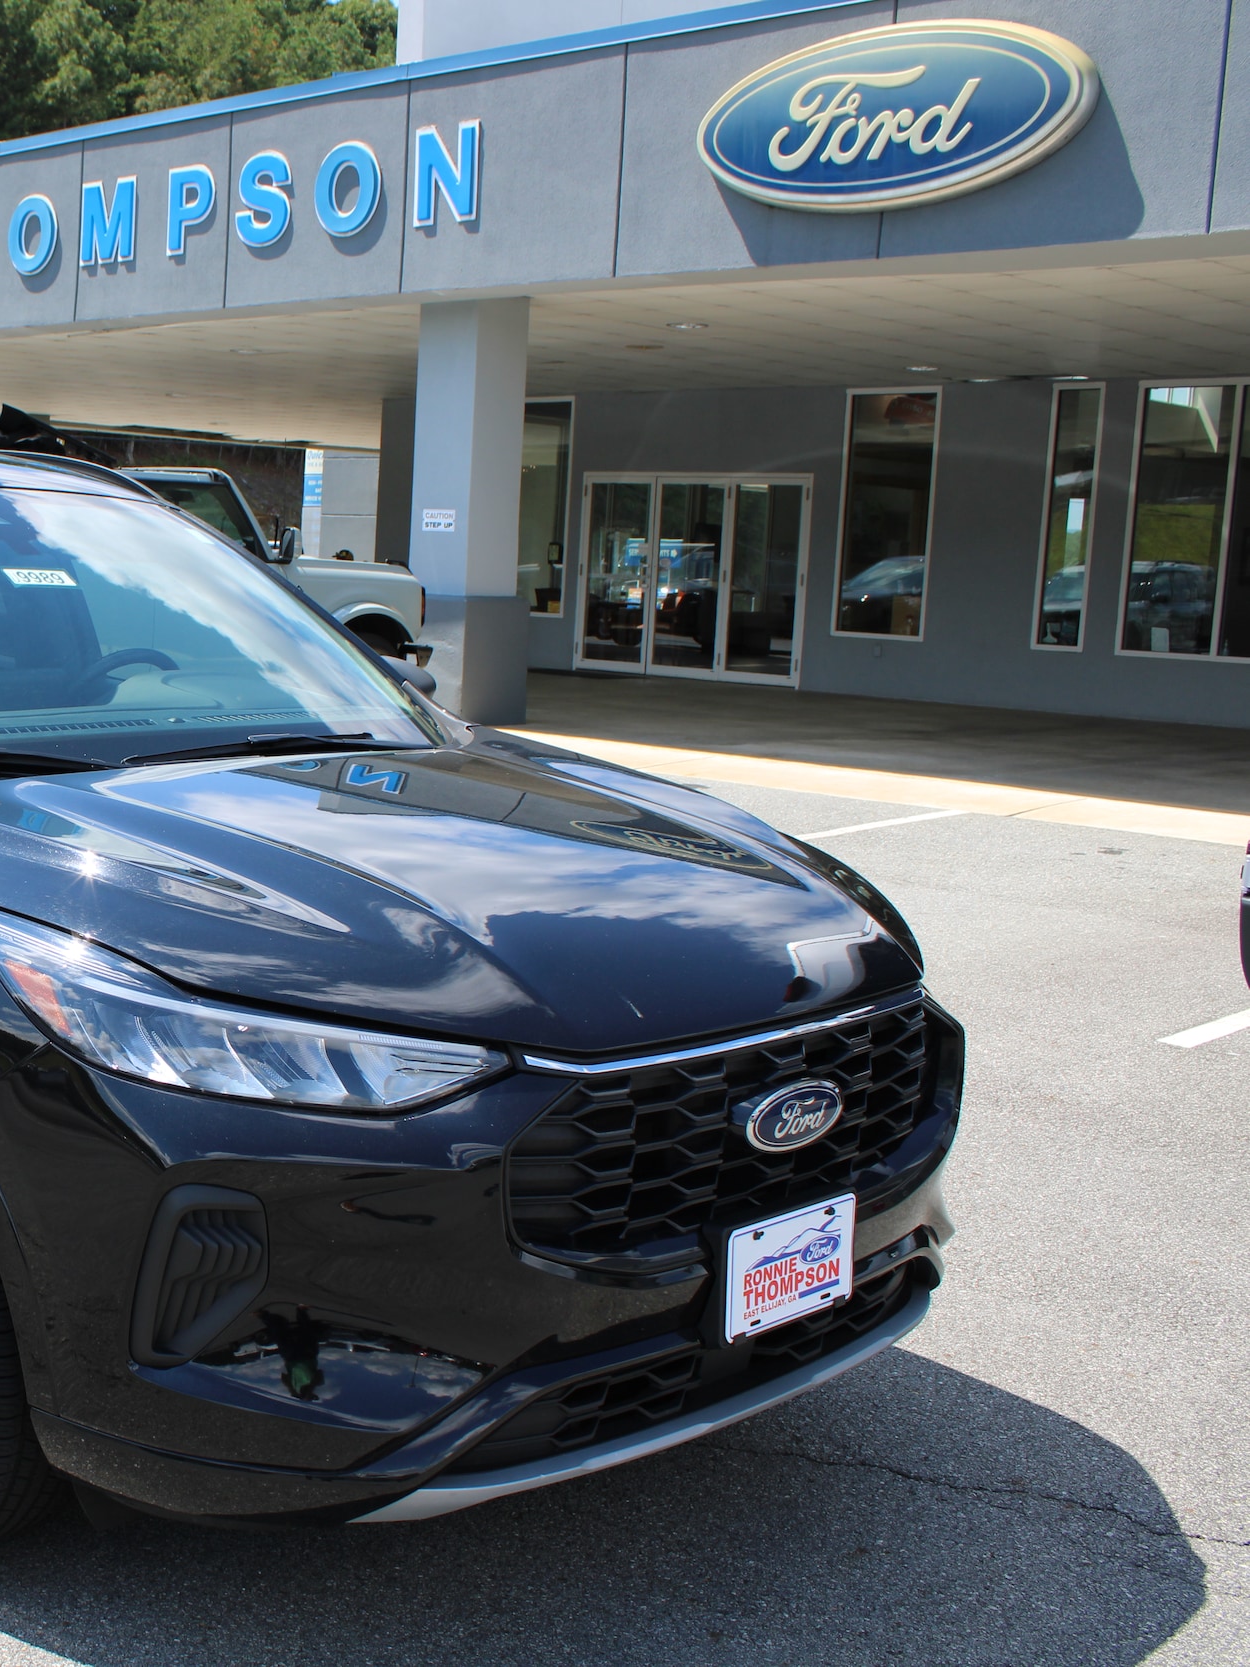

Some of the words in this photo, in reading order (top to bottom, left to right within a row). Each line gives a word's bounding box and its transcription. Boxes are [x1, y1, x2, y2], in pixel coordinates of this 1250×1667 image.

[768, 65, 982, 172] Ford
[424, 521, 442, 529] STEP
[425, 512, 454, 520] CAUTION
[16, 571, 65, 584] 9989
[774, 1096, 827, 1139] Ford
[806, 1238, 833, 1261] Ford
[743, 1256, 798, 1291] RONNIE
[743, 1257, 840, 1310] THOMPSON
[743, 1307, 759, 1320] EAST
[787, 1294, 797, 1303] GA
